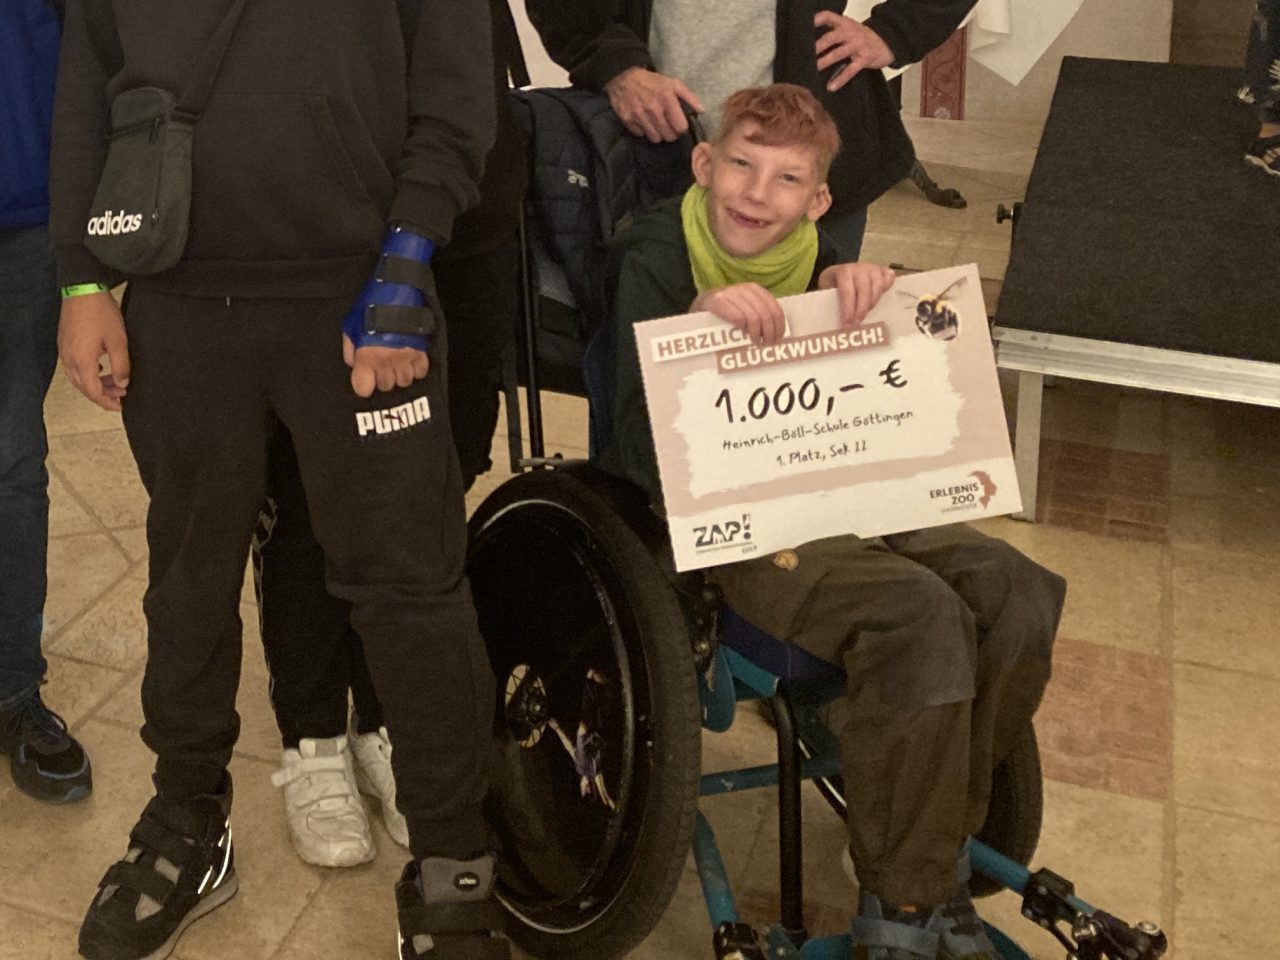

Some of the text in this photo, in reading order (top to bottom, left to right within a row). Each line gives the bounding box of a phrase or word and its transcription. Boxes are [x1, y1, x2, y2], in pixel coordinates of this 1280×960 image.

[87, 209, 143, 235] adidas
[720, 326, 885, 371] GLÜCKWUNSCH!
[879, 359, 908, 389] €
[355, 395, 432, 437] PUMA
[775, 454, 787, 466] 1.
[789, 449, 826, 465] Platz,
[829, 444, 850, 457] Sek
[929, 482, 980, 499] ERLEBNIS
[951, 493, 976, 505] ZOO
[692, 513, 752, 548] ZAP!
